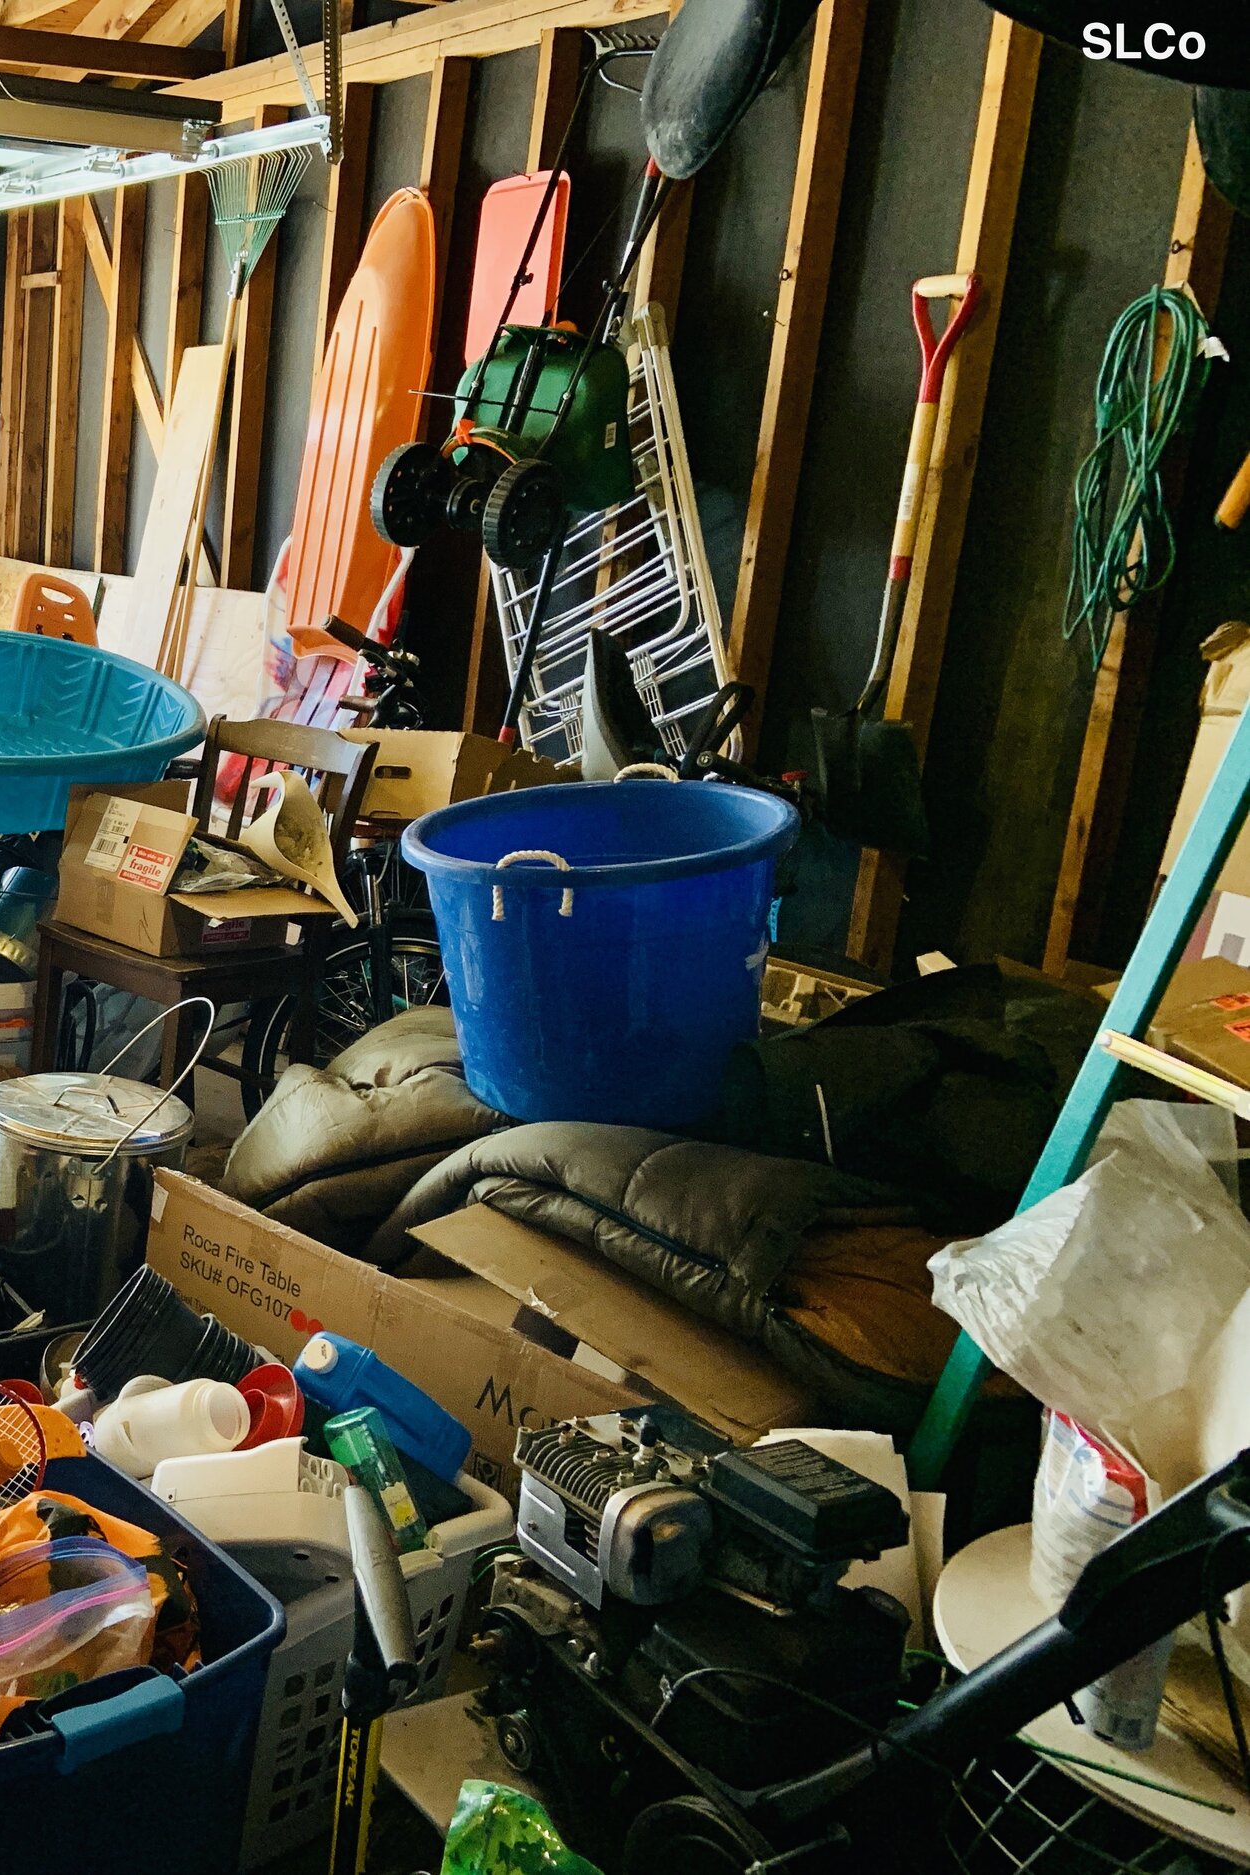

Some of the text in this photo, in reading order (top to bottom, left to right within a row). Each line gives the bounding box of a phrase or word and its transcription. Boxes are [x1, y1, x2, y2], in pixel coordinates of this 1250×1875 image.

[129, 858, 162, 877] fragile
[180, 1251, 293, 1321] SKU# OFG107
[183, 1224, 301, 1297] Roca Fire Table
[345, 1727, 361, 1808] TOPEAK
